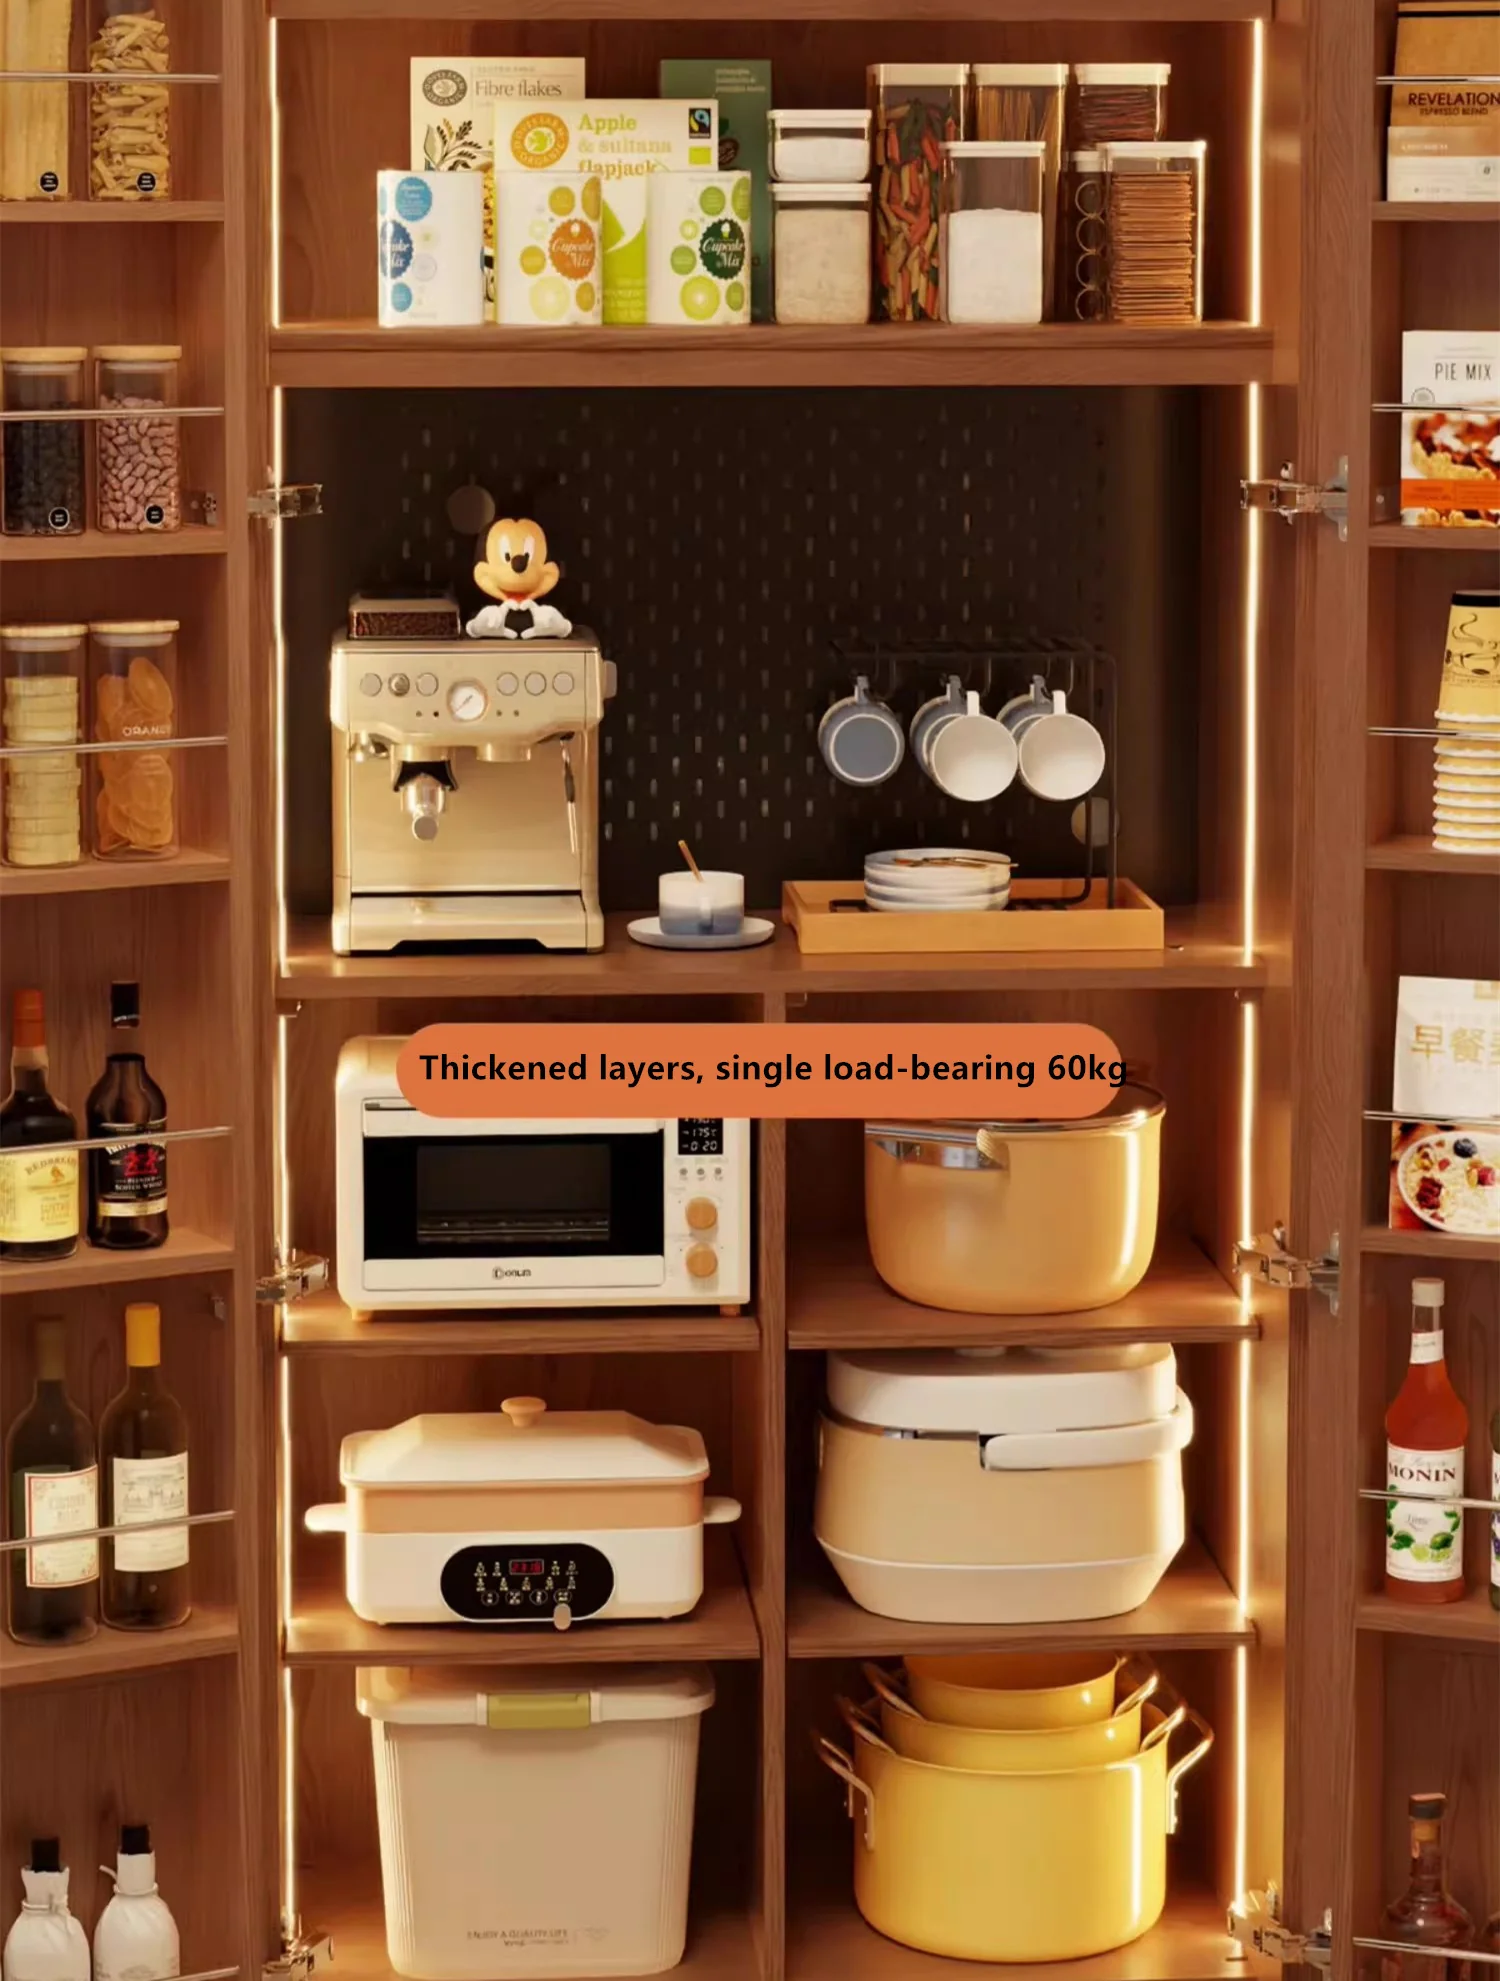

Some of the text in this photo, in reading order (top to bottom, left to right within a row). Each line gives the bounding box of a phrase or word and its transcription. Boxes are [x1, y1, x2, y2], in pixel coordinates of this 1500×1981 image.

[475, 79, 562, 96] Fibre flakes
[1408, 92, 1500, 106] REVELATION
[578, 114, 637, 135] Apple
[602, 138, 672, 153] sultana
[578, 159, 658, 180] flapjack
[551, 236, 594, 256] Cupcake
[701, 236, 745, 256] Cupcake
[717, 252, 741, 269] Mix
[1435, 363, 1491, 380] PIE MIX
[1388, 1462, 1456, 1481] MONIN
